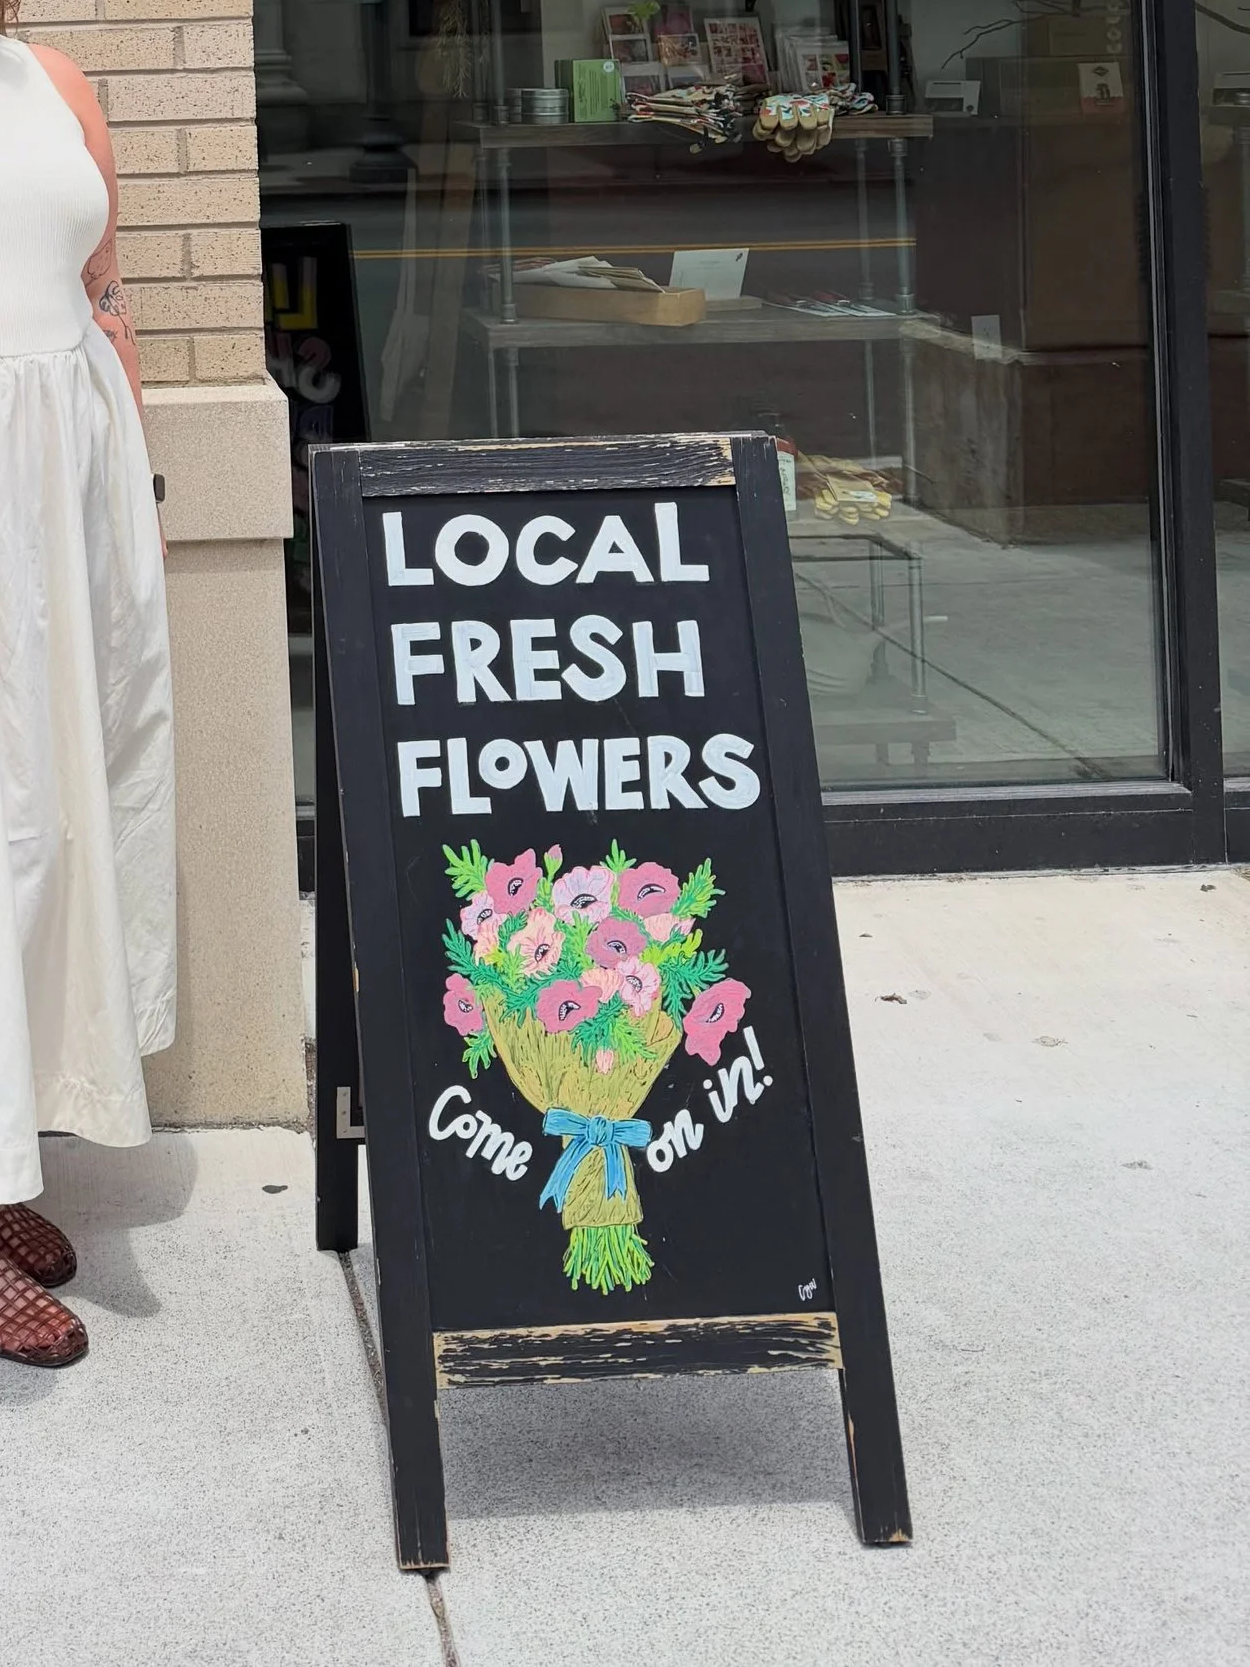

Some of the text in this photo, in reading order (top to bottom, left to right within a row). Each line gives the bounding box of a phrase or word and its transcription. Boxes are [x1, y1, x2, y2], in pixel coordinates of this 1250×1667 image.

[381, 502, 710, 587] LOCAL
[390, 615, 705, 706] FRESH
[396, 733, 761, 818] FLOWERS
[428, 1026, 774, 1181] Come on in!
